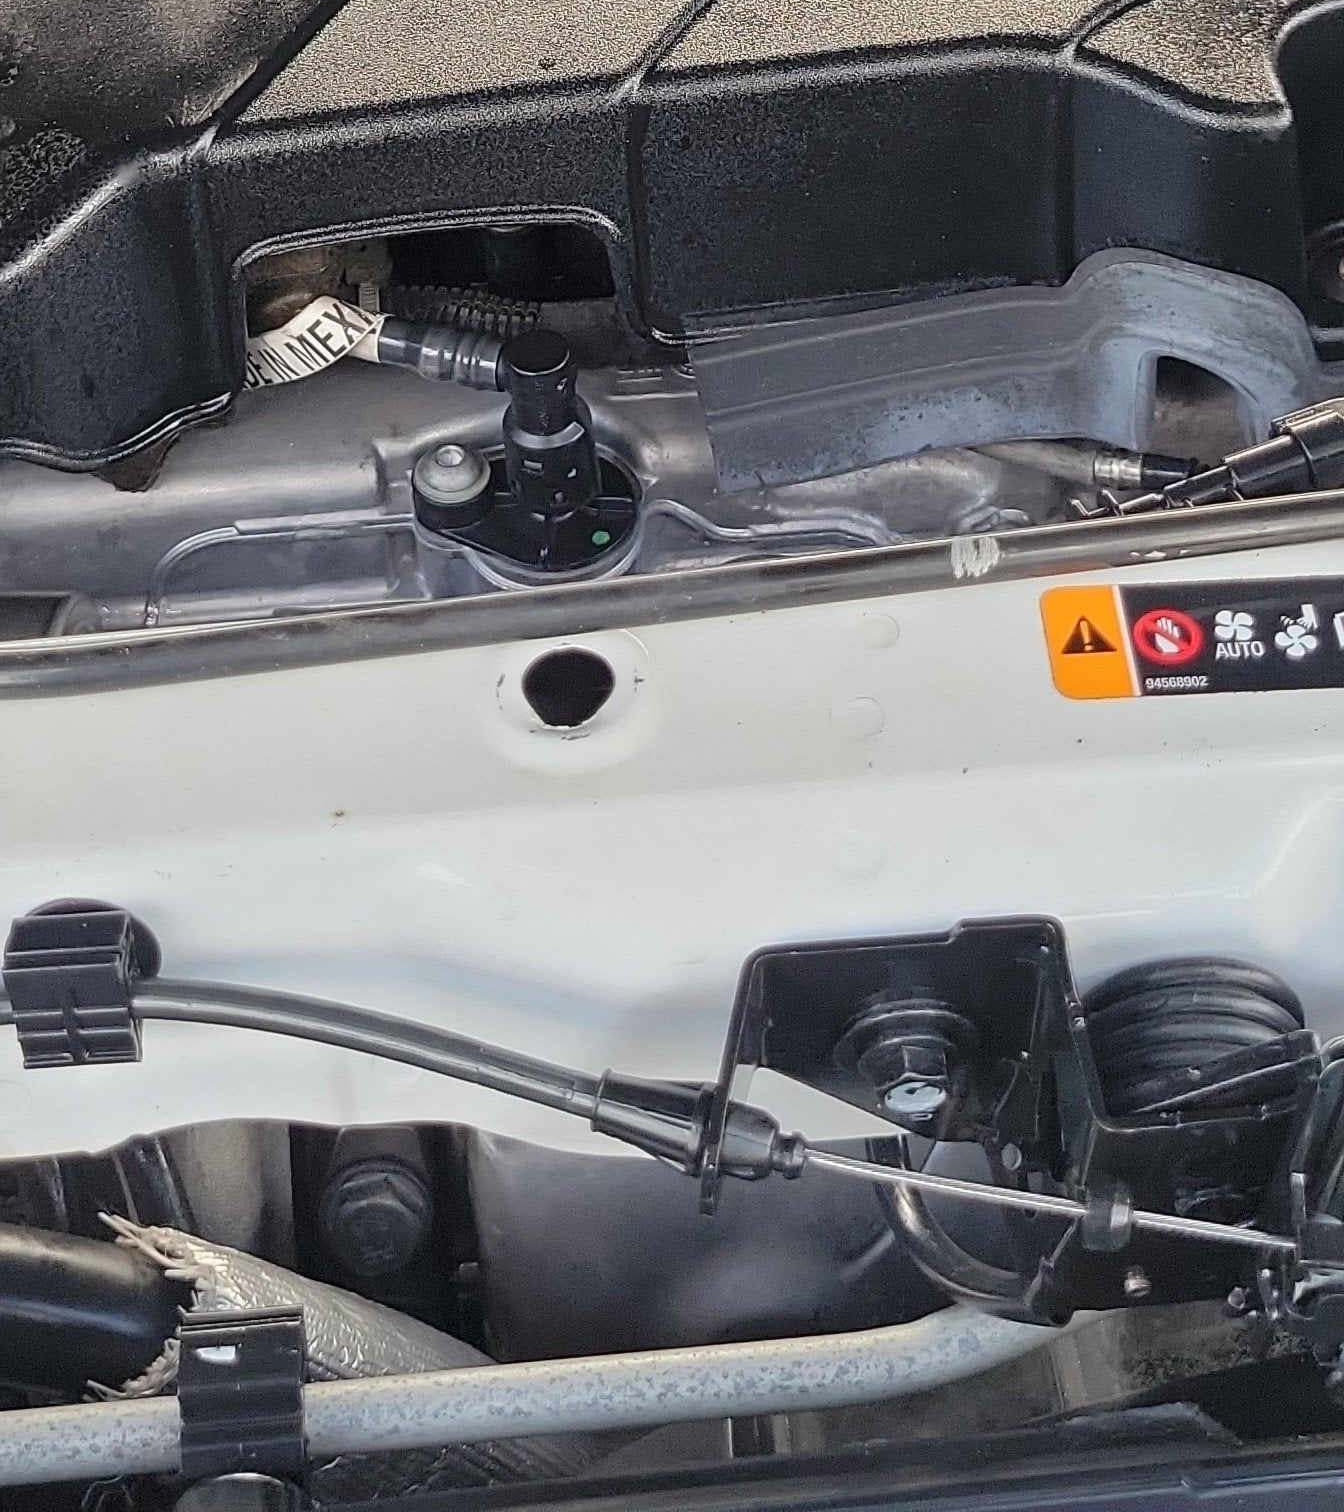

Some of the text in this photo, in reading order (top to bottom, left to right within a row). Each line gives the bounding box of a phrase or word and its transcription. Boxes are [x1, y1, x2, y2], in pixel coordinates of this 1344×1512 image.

[258, 347, 301, 381] IN
[1215, 641, 1265, 659] AUTO
[1144, 675, 1209, 689] 94568902
